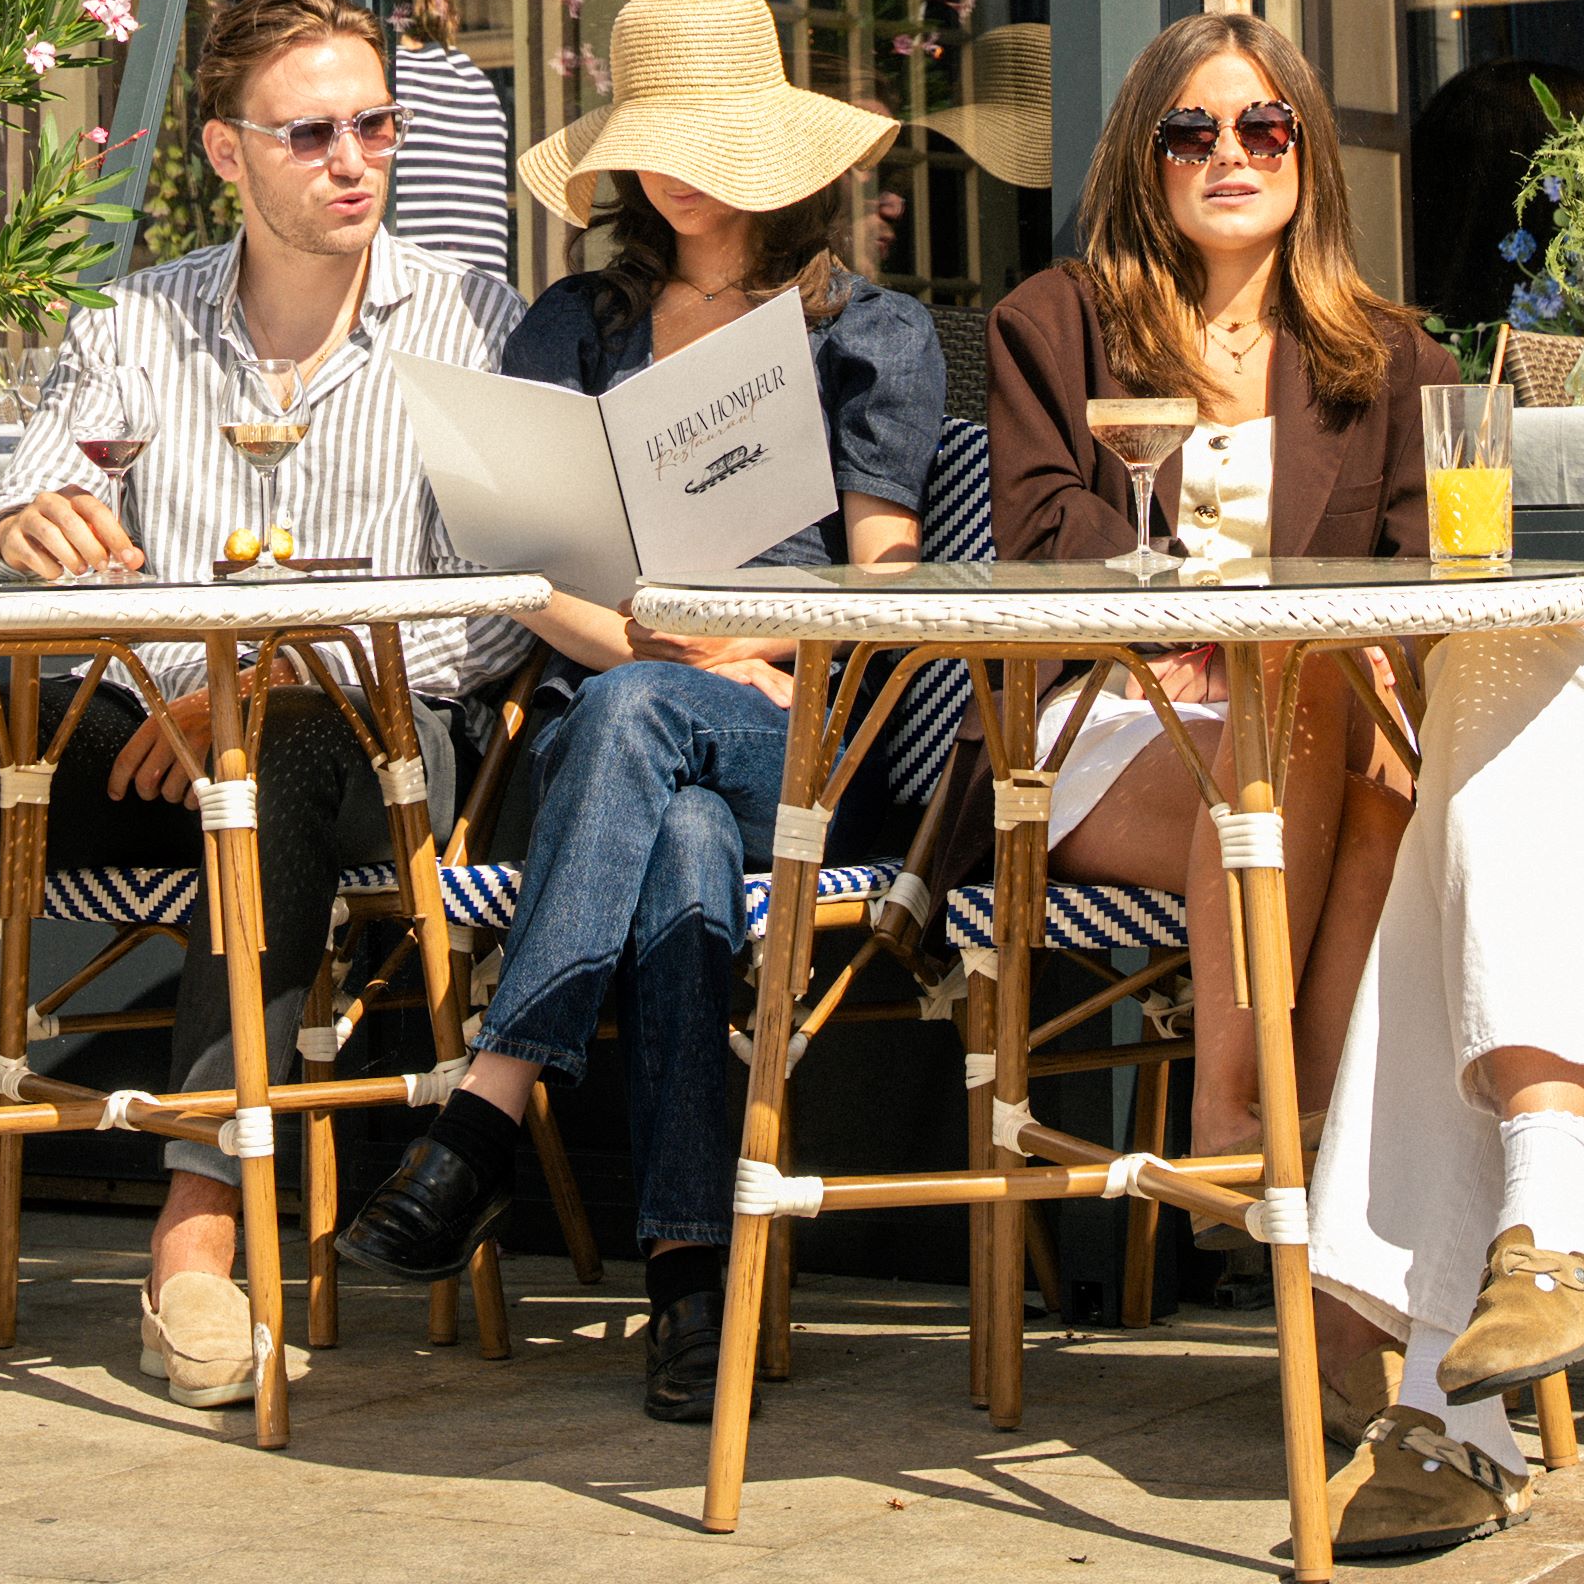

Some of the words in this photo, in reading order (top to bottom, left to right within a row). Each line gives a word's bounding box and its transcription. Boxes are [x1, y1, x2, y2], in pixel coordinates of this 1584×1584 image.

[646, 433, 663, 462] LE
[667, 408, 708, 447] VIEUX
[710, 365, 785, 425] HONFLEUR
